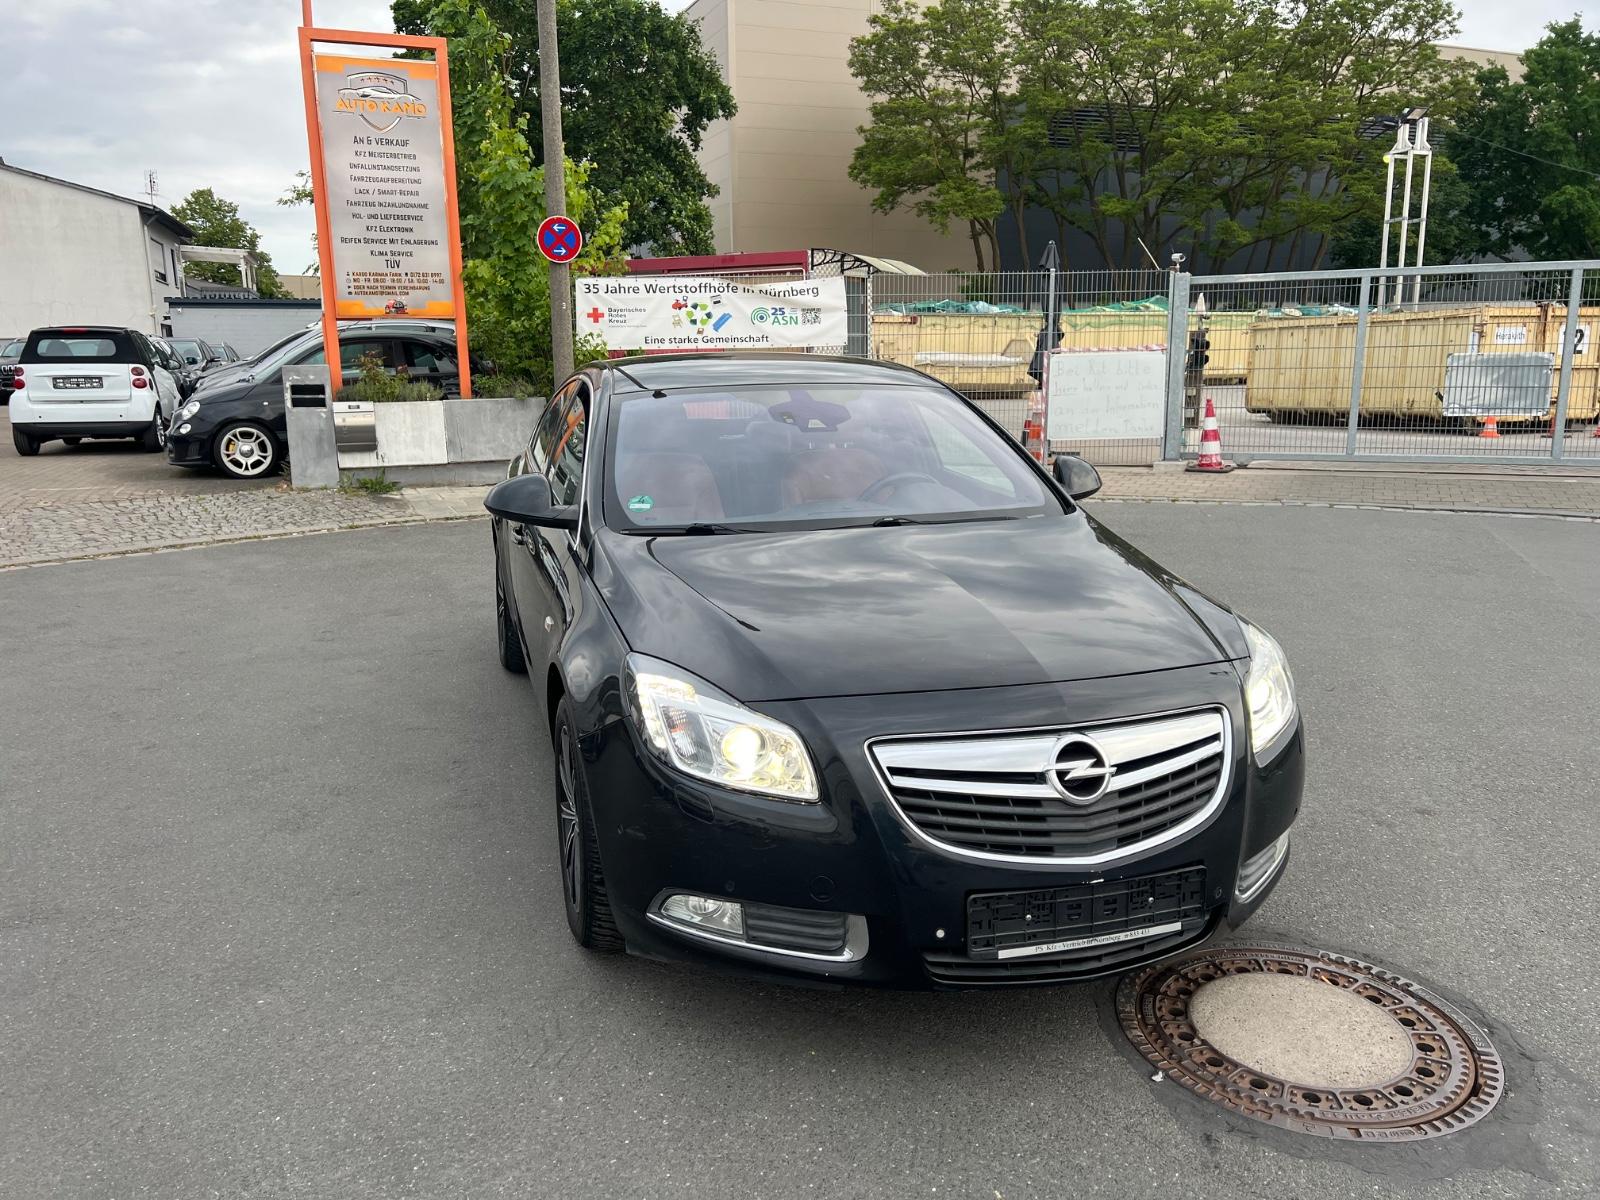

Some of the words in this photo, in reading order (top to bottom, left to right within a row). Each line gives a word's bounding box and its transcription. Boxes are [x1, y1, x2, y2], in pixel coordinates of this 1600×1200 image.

[336, 97, 378, 112] AUTO
[353, 136, 364, 144] AN
[374, 138, 410, 147] VERKAUF
[368, 151, 416, 160] MEISTERBETRIEB
[349, 163, 420, 172] UNFALLINSTANDSETZUNG
[350, 175, 422, 184] FAHRZEUGAUFBEREITUNG
[385, 257, 400, 268] TÜV
[584, 284, 600, 294] 35
[604, 283, 640, 294] Jahre
[646, 282, 738, 294] Wertstoffhöfe
[759, 285, 819, 298] Nürnberg
[771, 307, 785, 315] 25
[772, 316, 798, 325] ASN
[644, 336, 666, 344] Eine
[668, 336, 699, 344] starke
[702, 335, 769, 344] Gemeinschaft
[1116, 360, 1152, 376] bitte
[1092, 935, 1121, 944] Nürnberg
